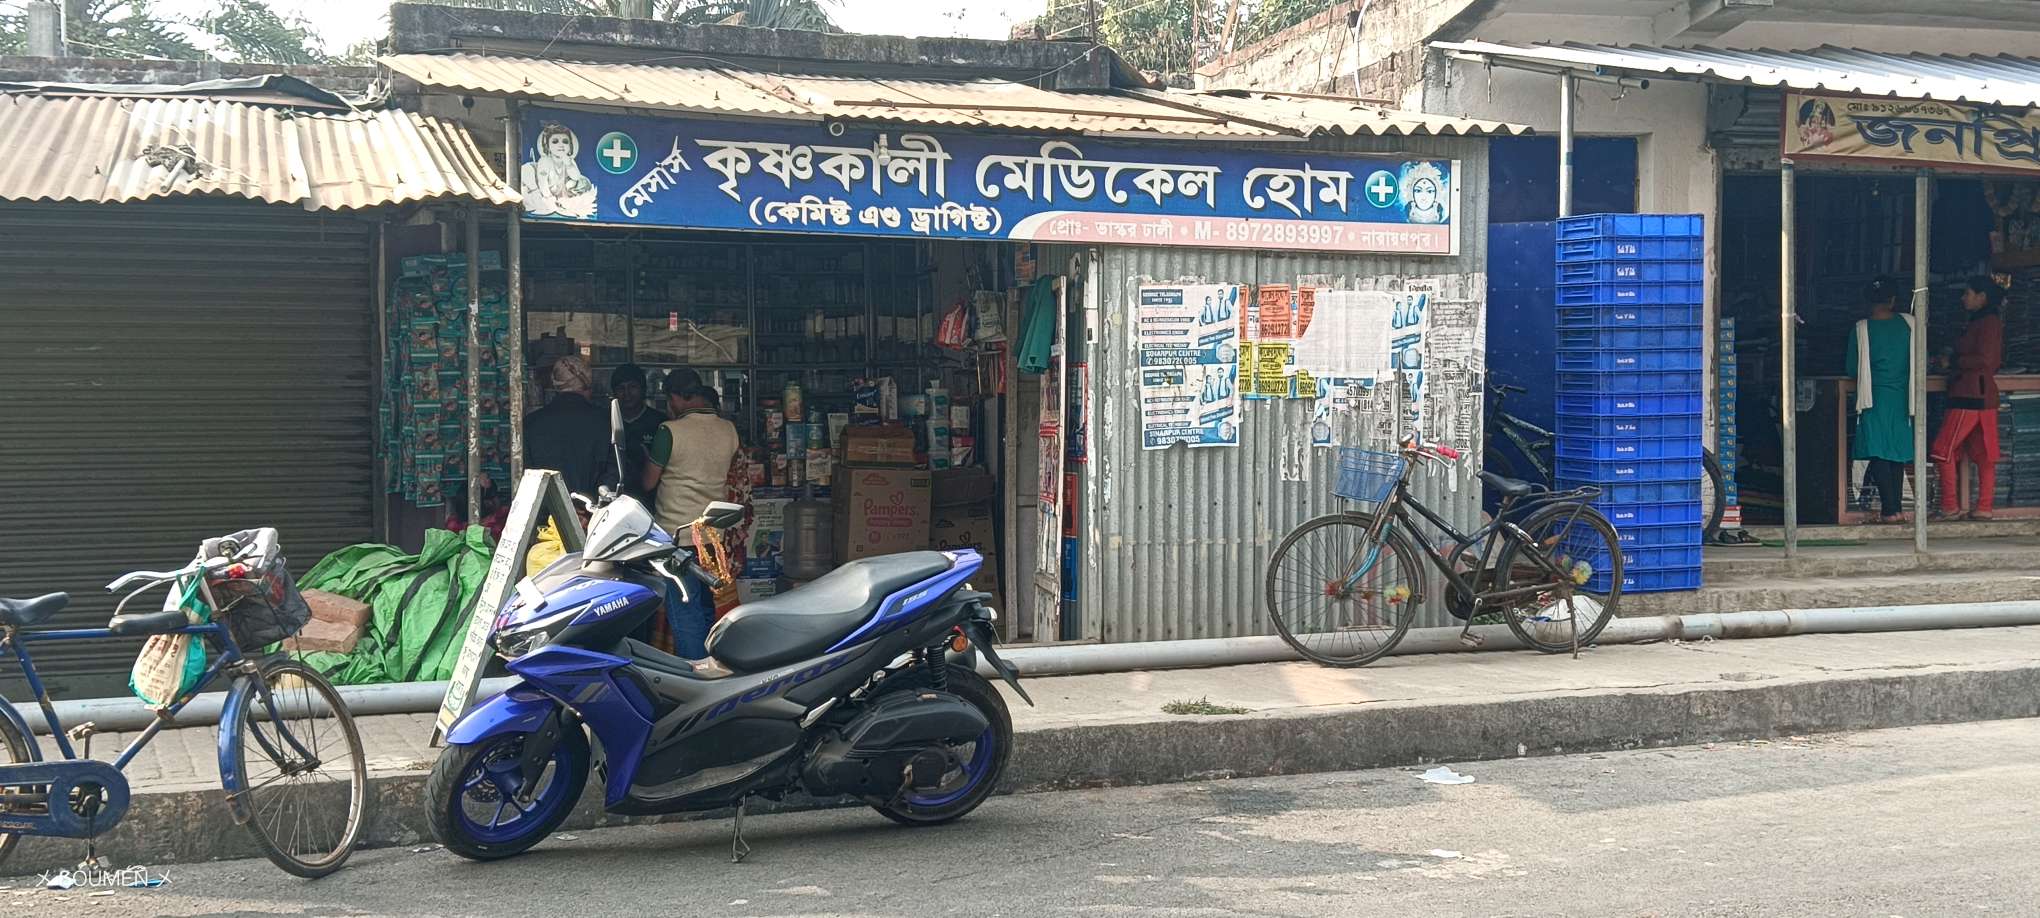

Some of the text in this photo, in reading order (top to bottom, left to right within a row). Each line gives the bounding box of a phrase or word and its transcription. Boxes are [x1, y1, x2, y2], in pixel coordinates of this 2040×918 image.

[618, 135, 693, 218] মেসার্স
[694, 133, 1355, 218] কৃষ্ণকালী মেডিকেল হোম
[1226, 221, 1345, 245] 8972893997
[863, 498, 919, 518] Pampers
[593, 596, 630, 617] YAMAHA
